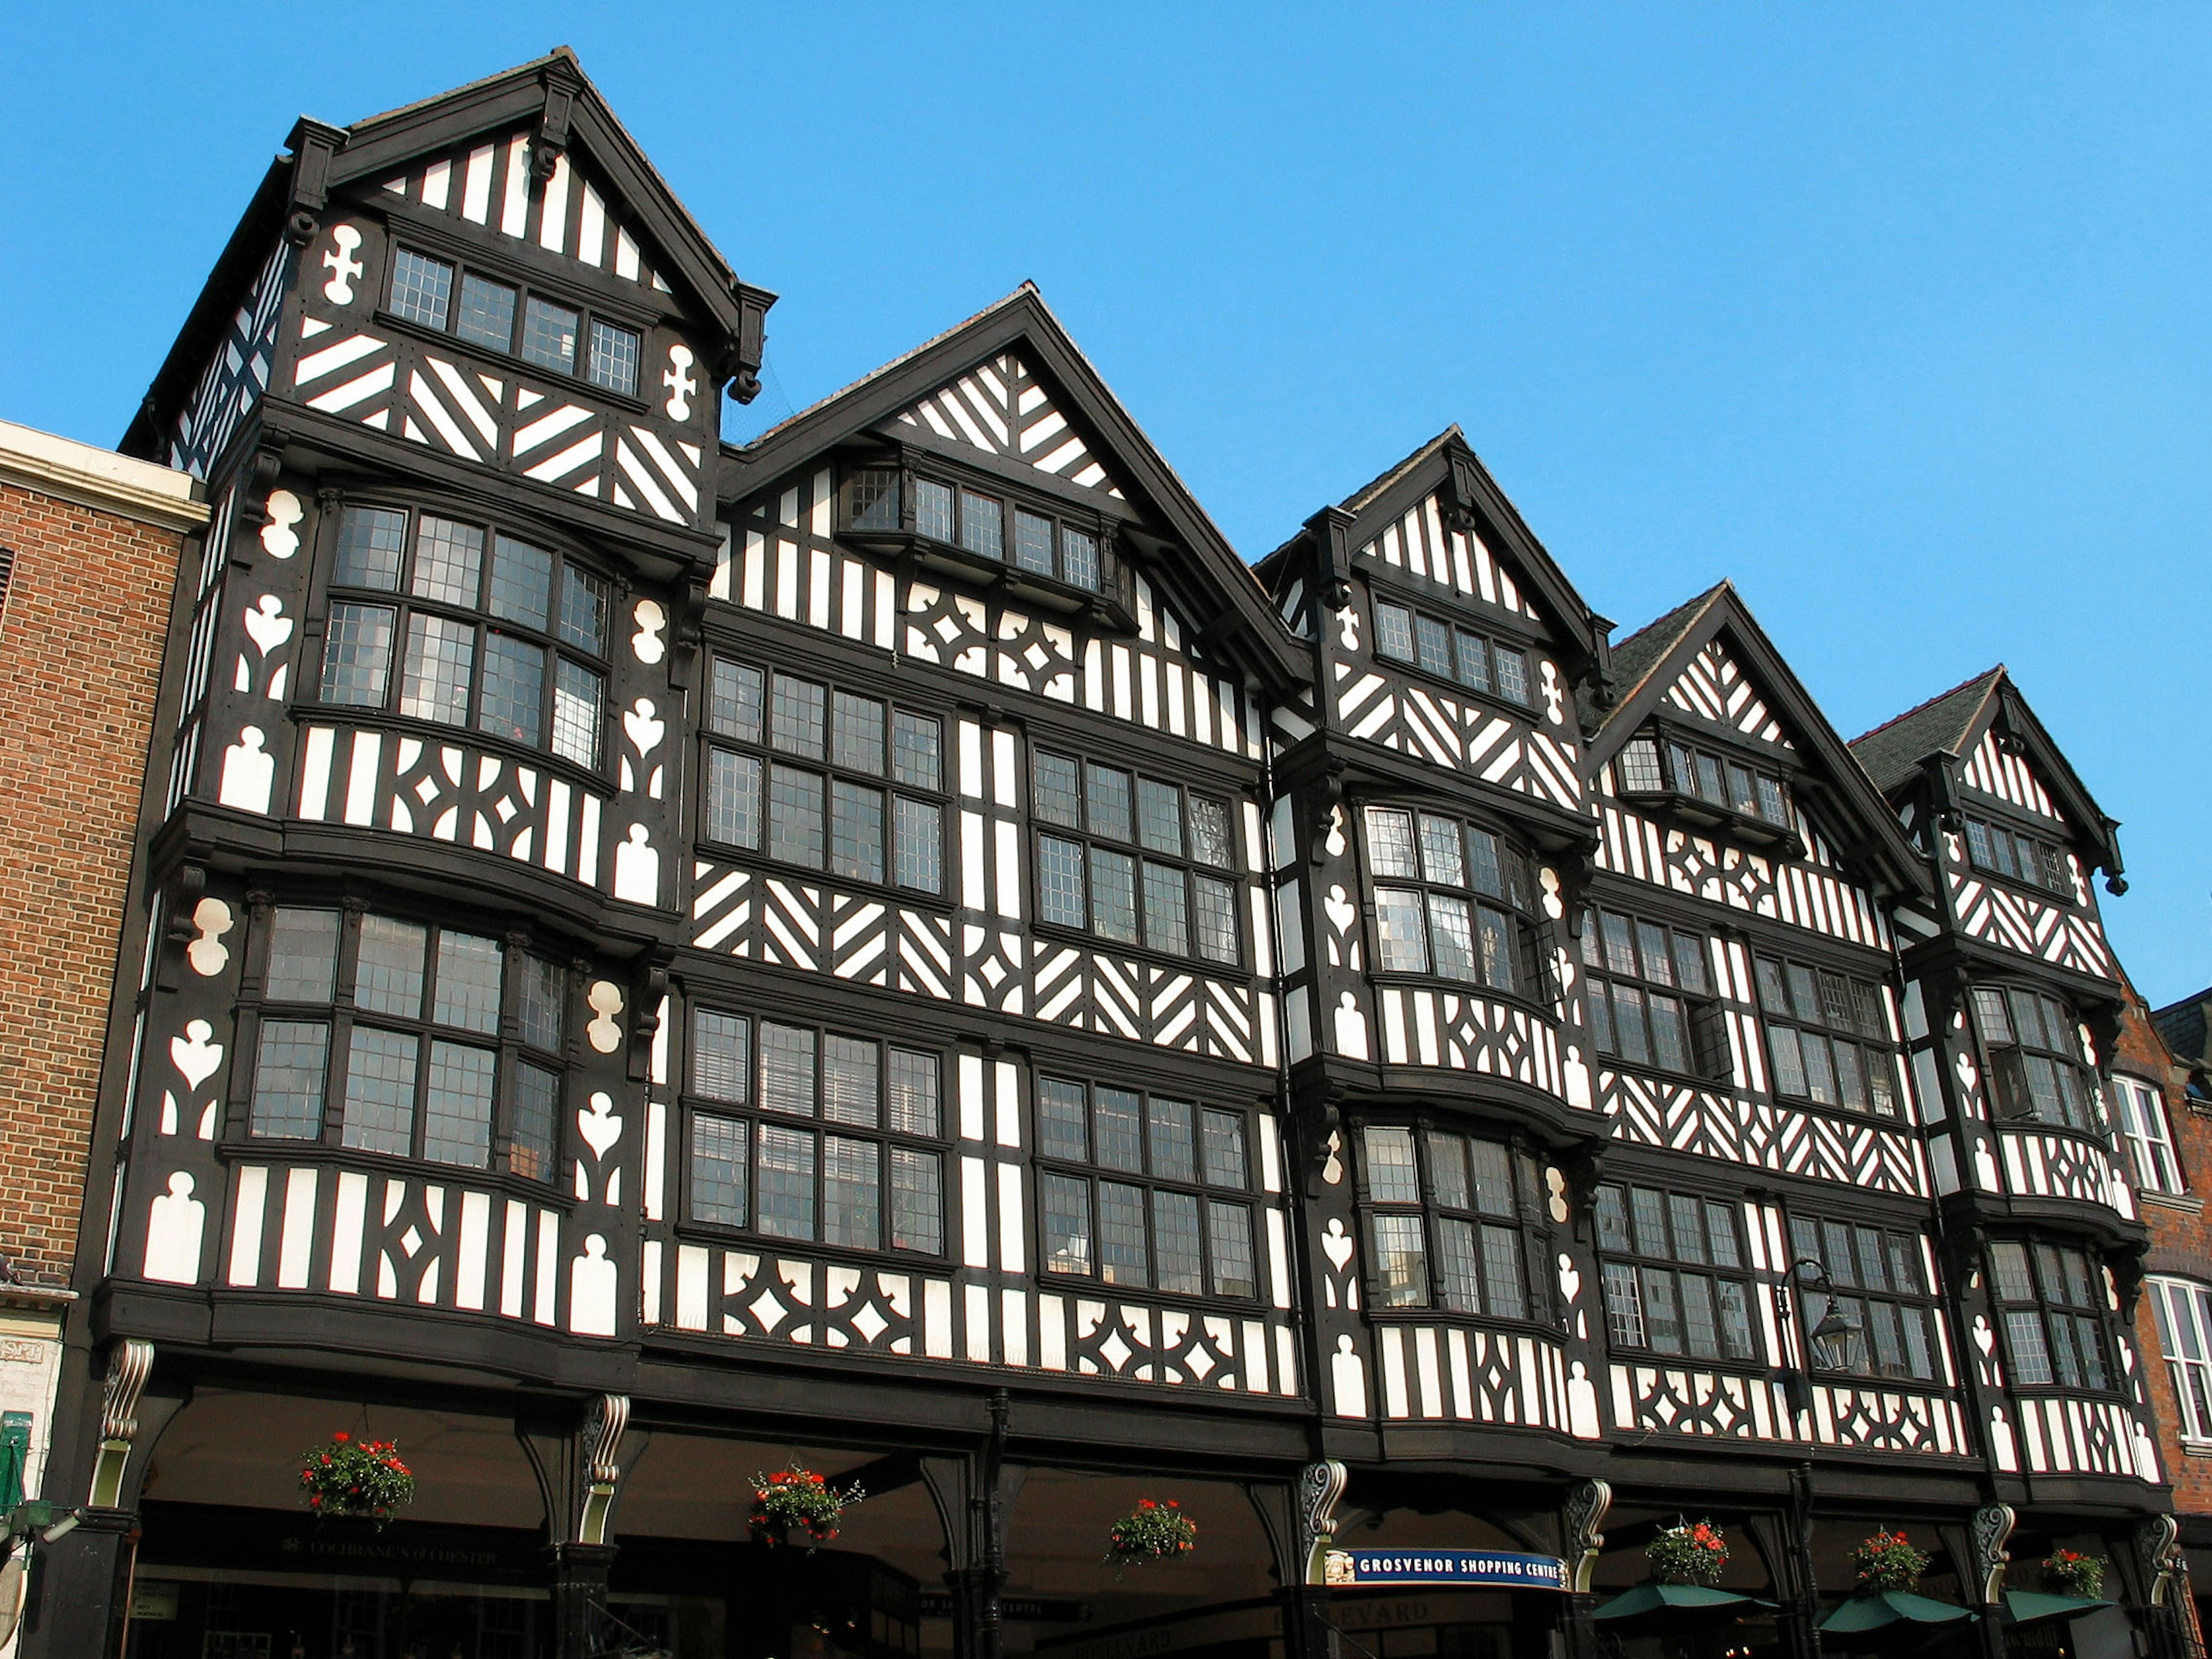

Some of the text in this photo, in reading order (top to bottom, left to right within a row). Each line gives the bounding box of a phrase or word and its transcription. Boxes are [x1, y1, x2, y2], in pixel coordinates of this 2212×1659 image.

[429, 1548, 497, 1566] CHESTER
[1359, 1558, 1558, 1580] GROSVENOR SHOPPING CENTRE
